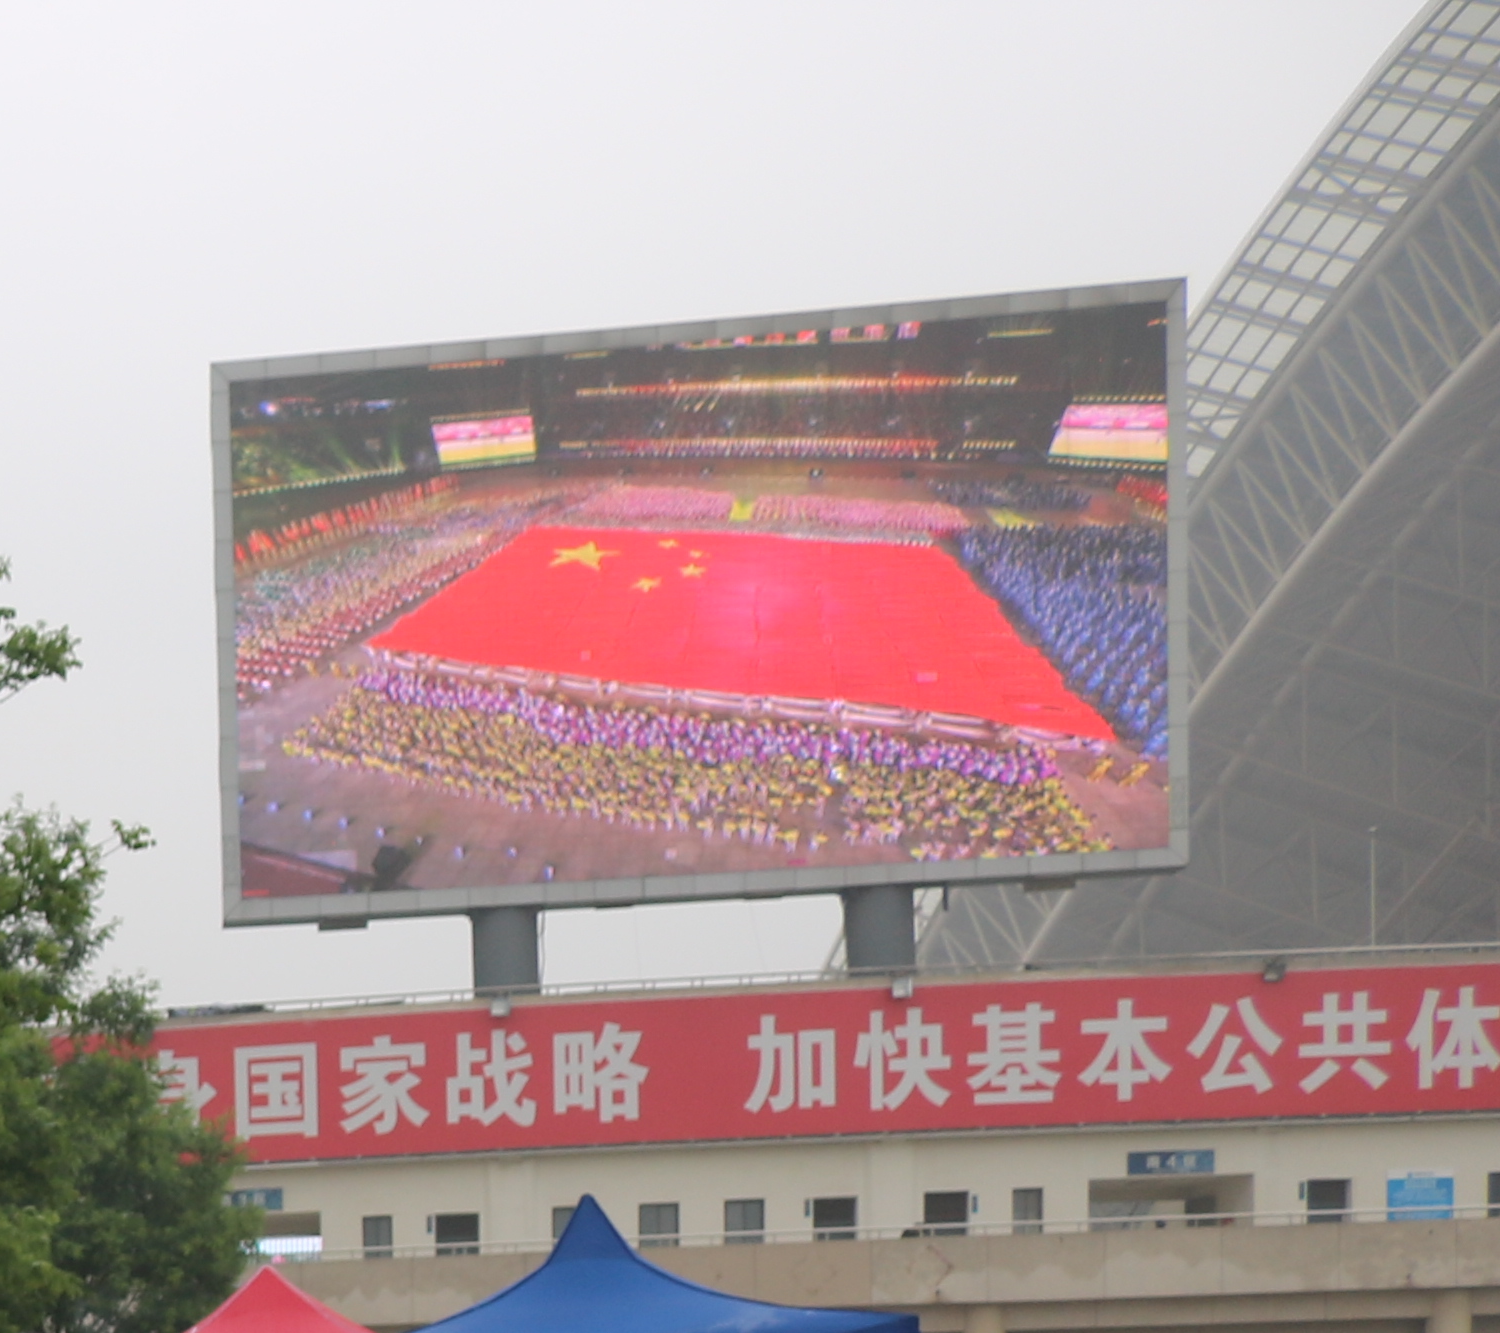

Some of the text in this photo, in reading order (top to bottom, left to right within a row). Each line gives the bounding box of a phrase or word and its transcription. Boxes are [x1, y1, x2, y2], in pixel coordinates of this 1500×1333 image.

[744, 986, 1500, 1113] 加快基本公共体
